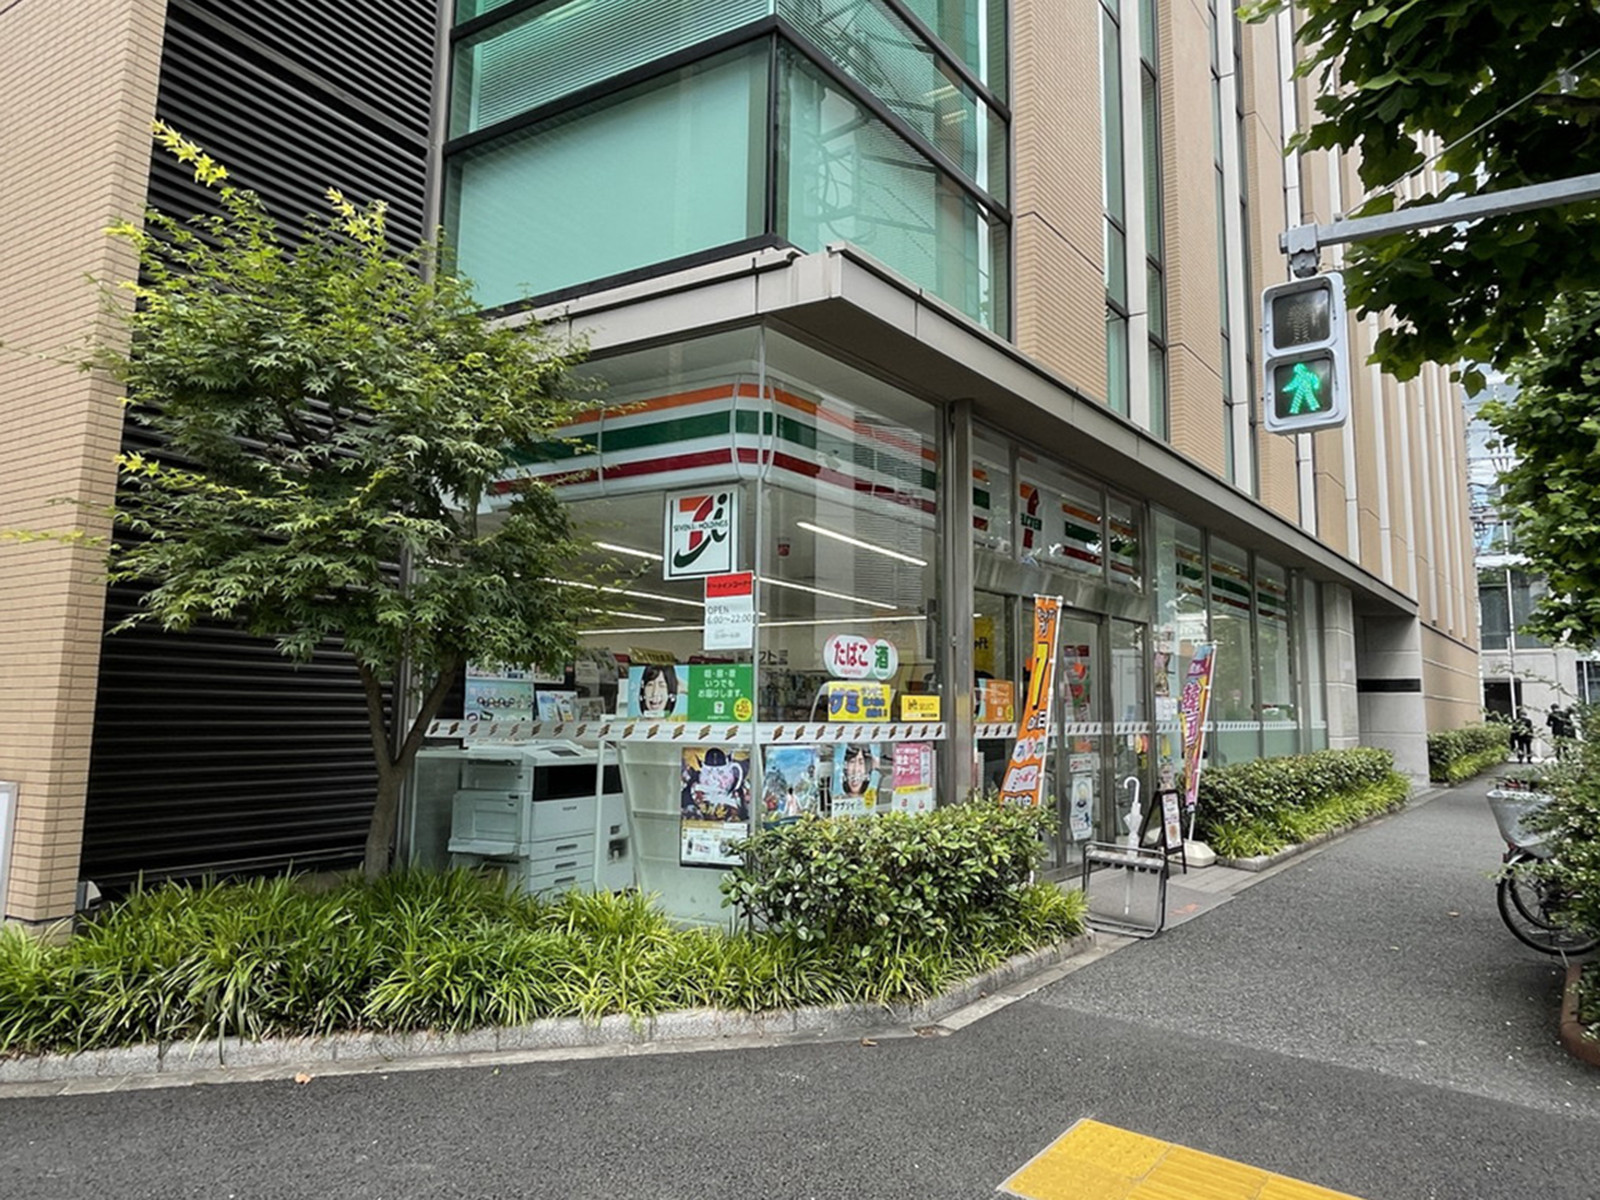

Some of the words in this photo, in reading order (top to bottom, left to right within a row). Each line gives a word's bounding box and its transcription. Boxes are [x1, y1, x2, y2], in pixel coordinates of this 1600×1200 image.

[707, 605, 730, 615] OPEN
[834, 641, 869, 667] たばこ
[705, 680, 735, 688] いつでも
